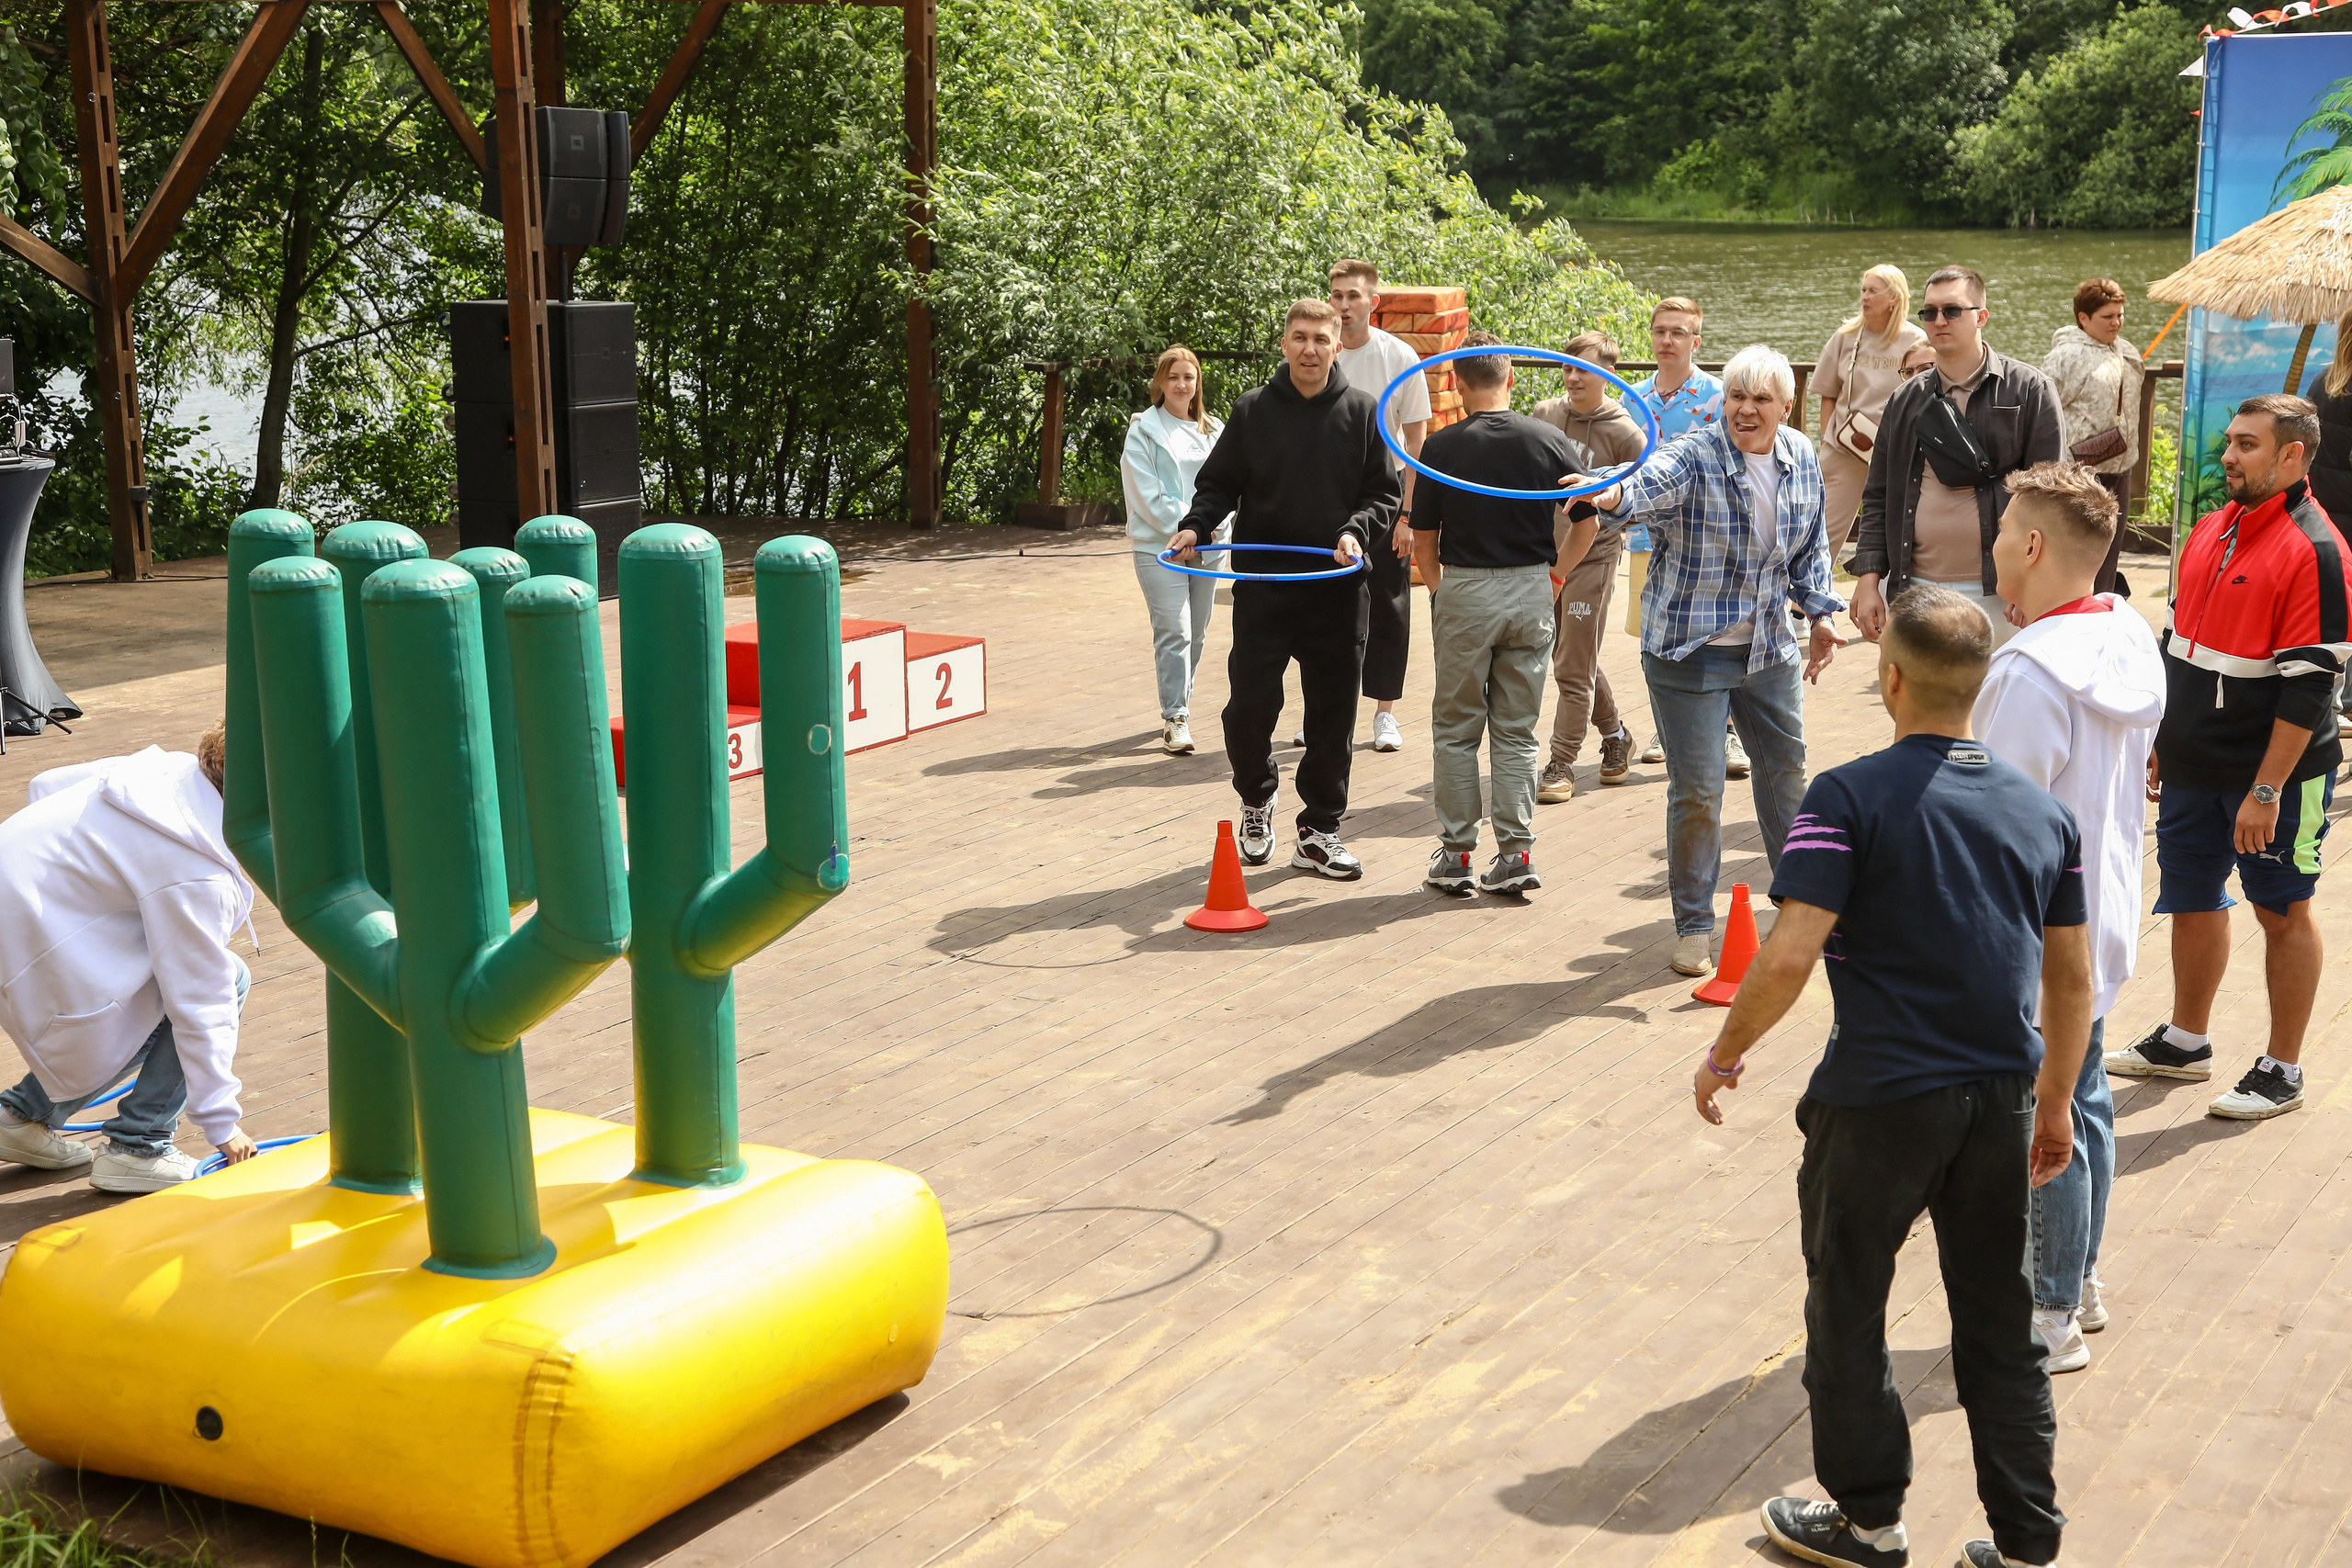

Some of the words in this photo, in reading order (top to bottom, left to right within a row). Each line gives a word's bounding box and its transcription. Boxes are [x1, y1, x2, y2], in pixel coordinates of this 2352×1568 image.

[1568, 601, 1591, 614] PUMA
[847, 660, 867, 722] 1
[935, 662, 953, 711] 2
[728, 733, 742, 769] 3
